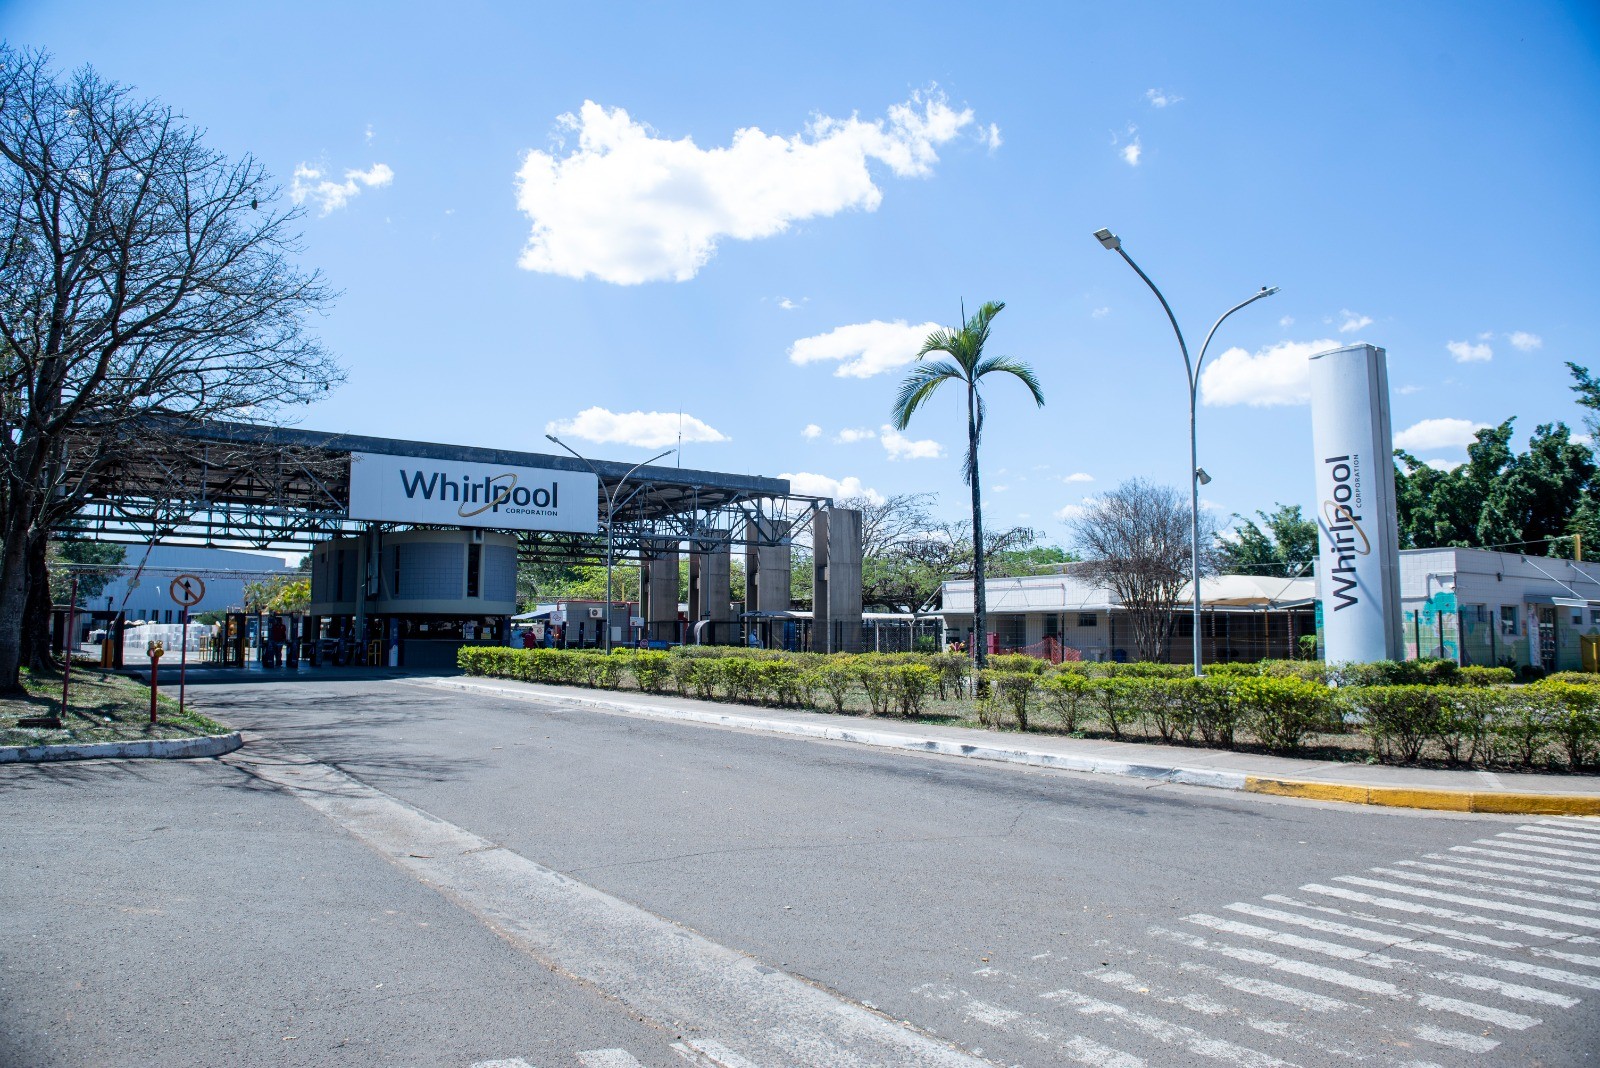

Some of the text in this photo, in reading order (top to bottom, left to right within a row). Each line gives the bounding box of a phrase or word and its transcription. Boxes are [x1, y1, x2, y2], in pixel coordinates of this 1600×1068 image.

[400, 470, 558, 513] Whirlpool
[1353, 454, 1362, 509] CORPORATION
[505, 507, 558, 517] CORPORATION
[1325, 455, 1362, 612] Whirlpool
